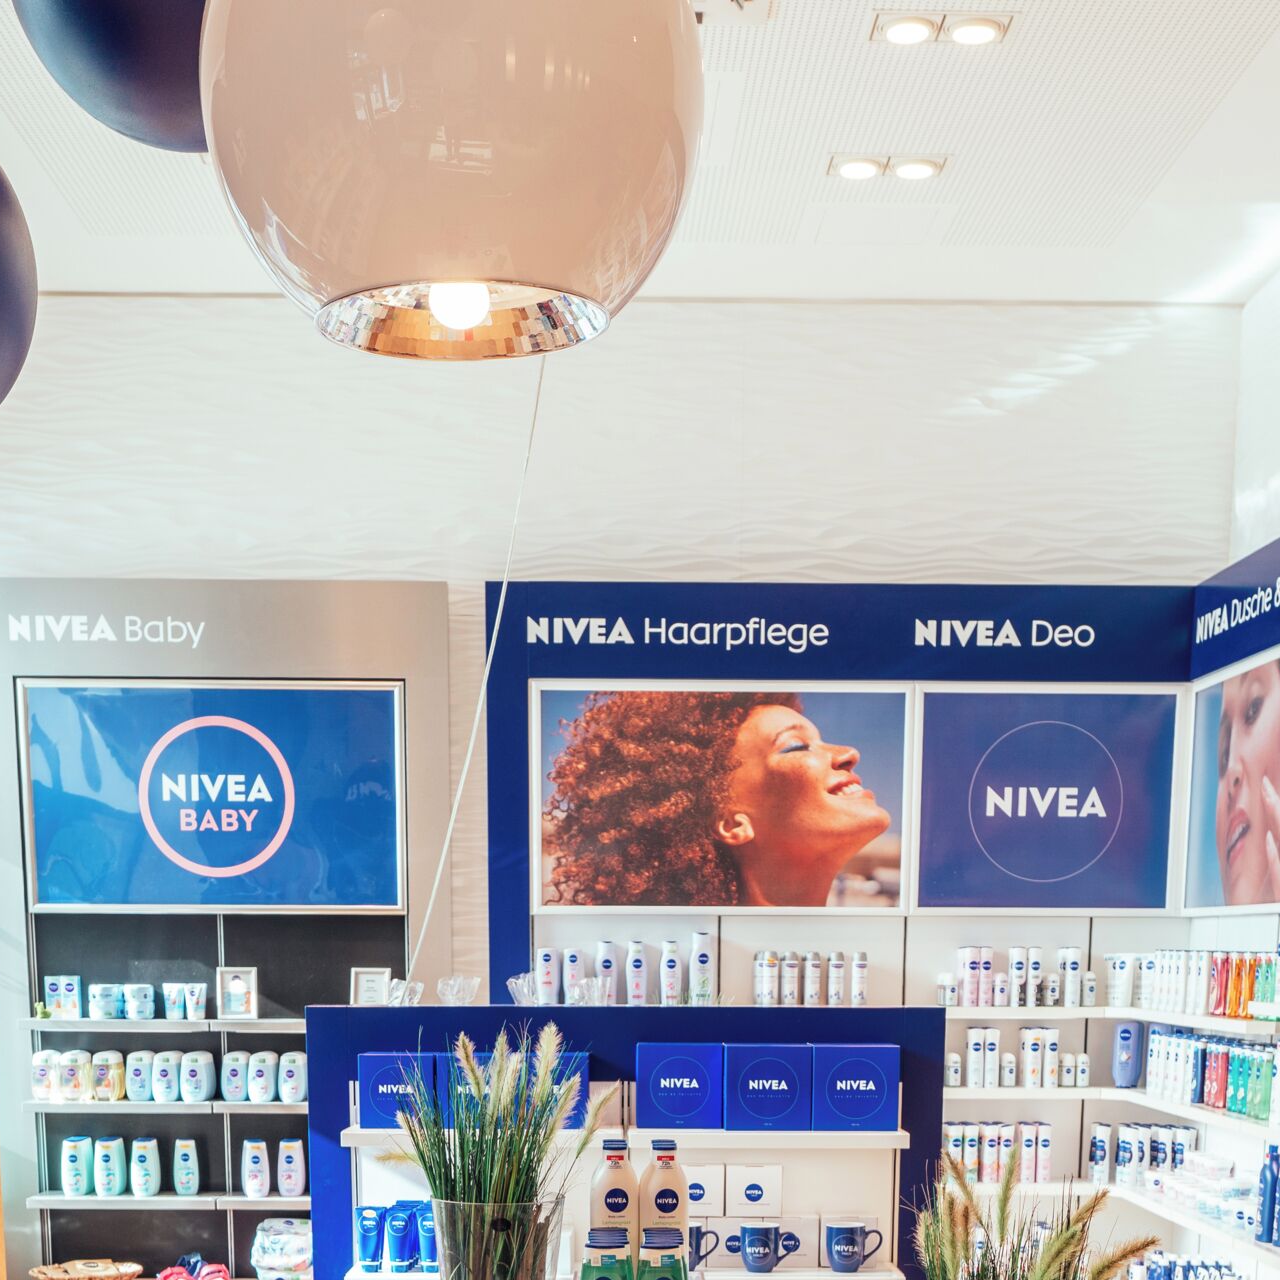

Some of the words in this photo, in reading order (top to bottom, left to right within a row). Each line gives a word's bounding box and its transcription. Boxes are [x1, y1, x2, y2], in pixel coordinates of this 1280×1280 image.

[1196, 606, 1229, 643] NIVEA
[1231, 586, 1272, 626] Dusche
[8, 613, 117, 643] NIVEA
[125, 616, 205, 648] Baby
[526, 615, 635, 645] NIVEA
[644, 617, 830, 653] Haarpflege
[915, 618, 1022, 647] NIVEA
[1031, 620, 1095, 647] Deo
[162, 773, 273, 802] NIVEA
[986, 786, 1107, 817] NIVEA
[180, 809, 259, 831] BABY
[378, 1084, 414, 1094] NIVEA
[660, 1078, 699, 1089] NIVEA
[749, 1079, 788, 1090] NIVEA
[836, 1080, 876, 1091] NIVEA
[746, 1246, 770, 1254] NIVEA
[835, 1244, 859, 1252] NIVEA
